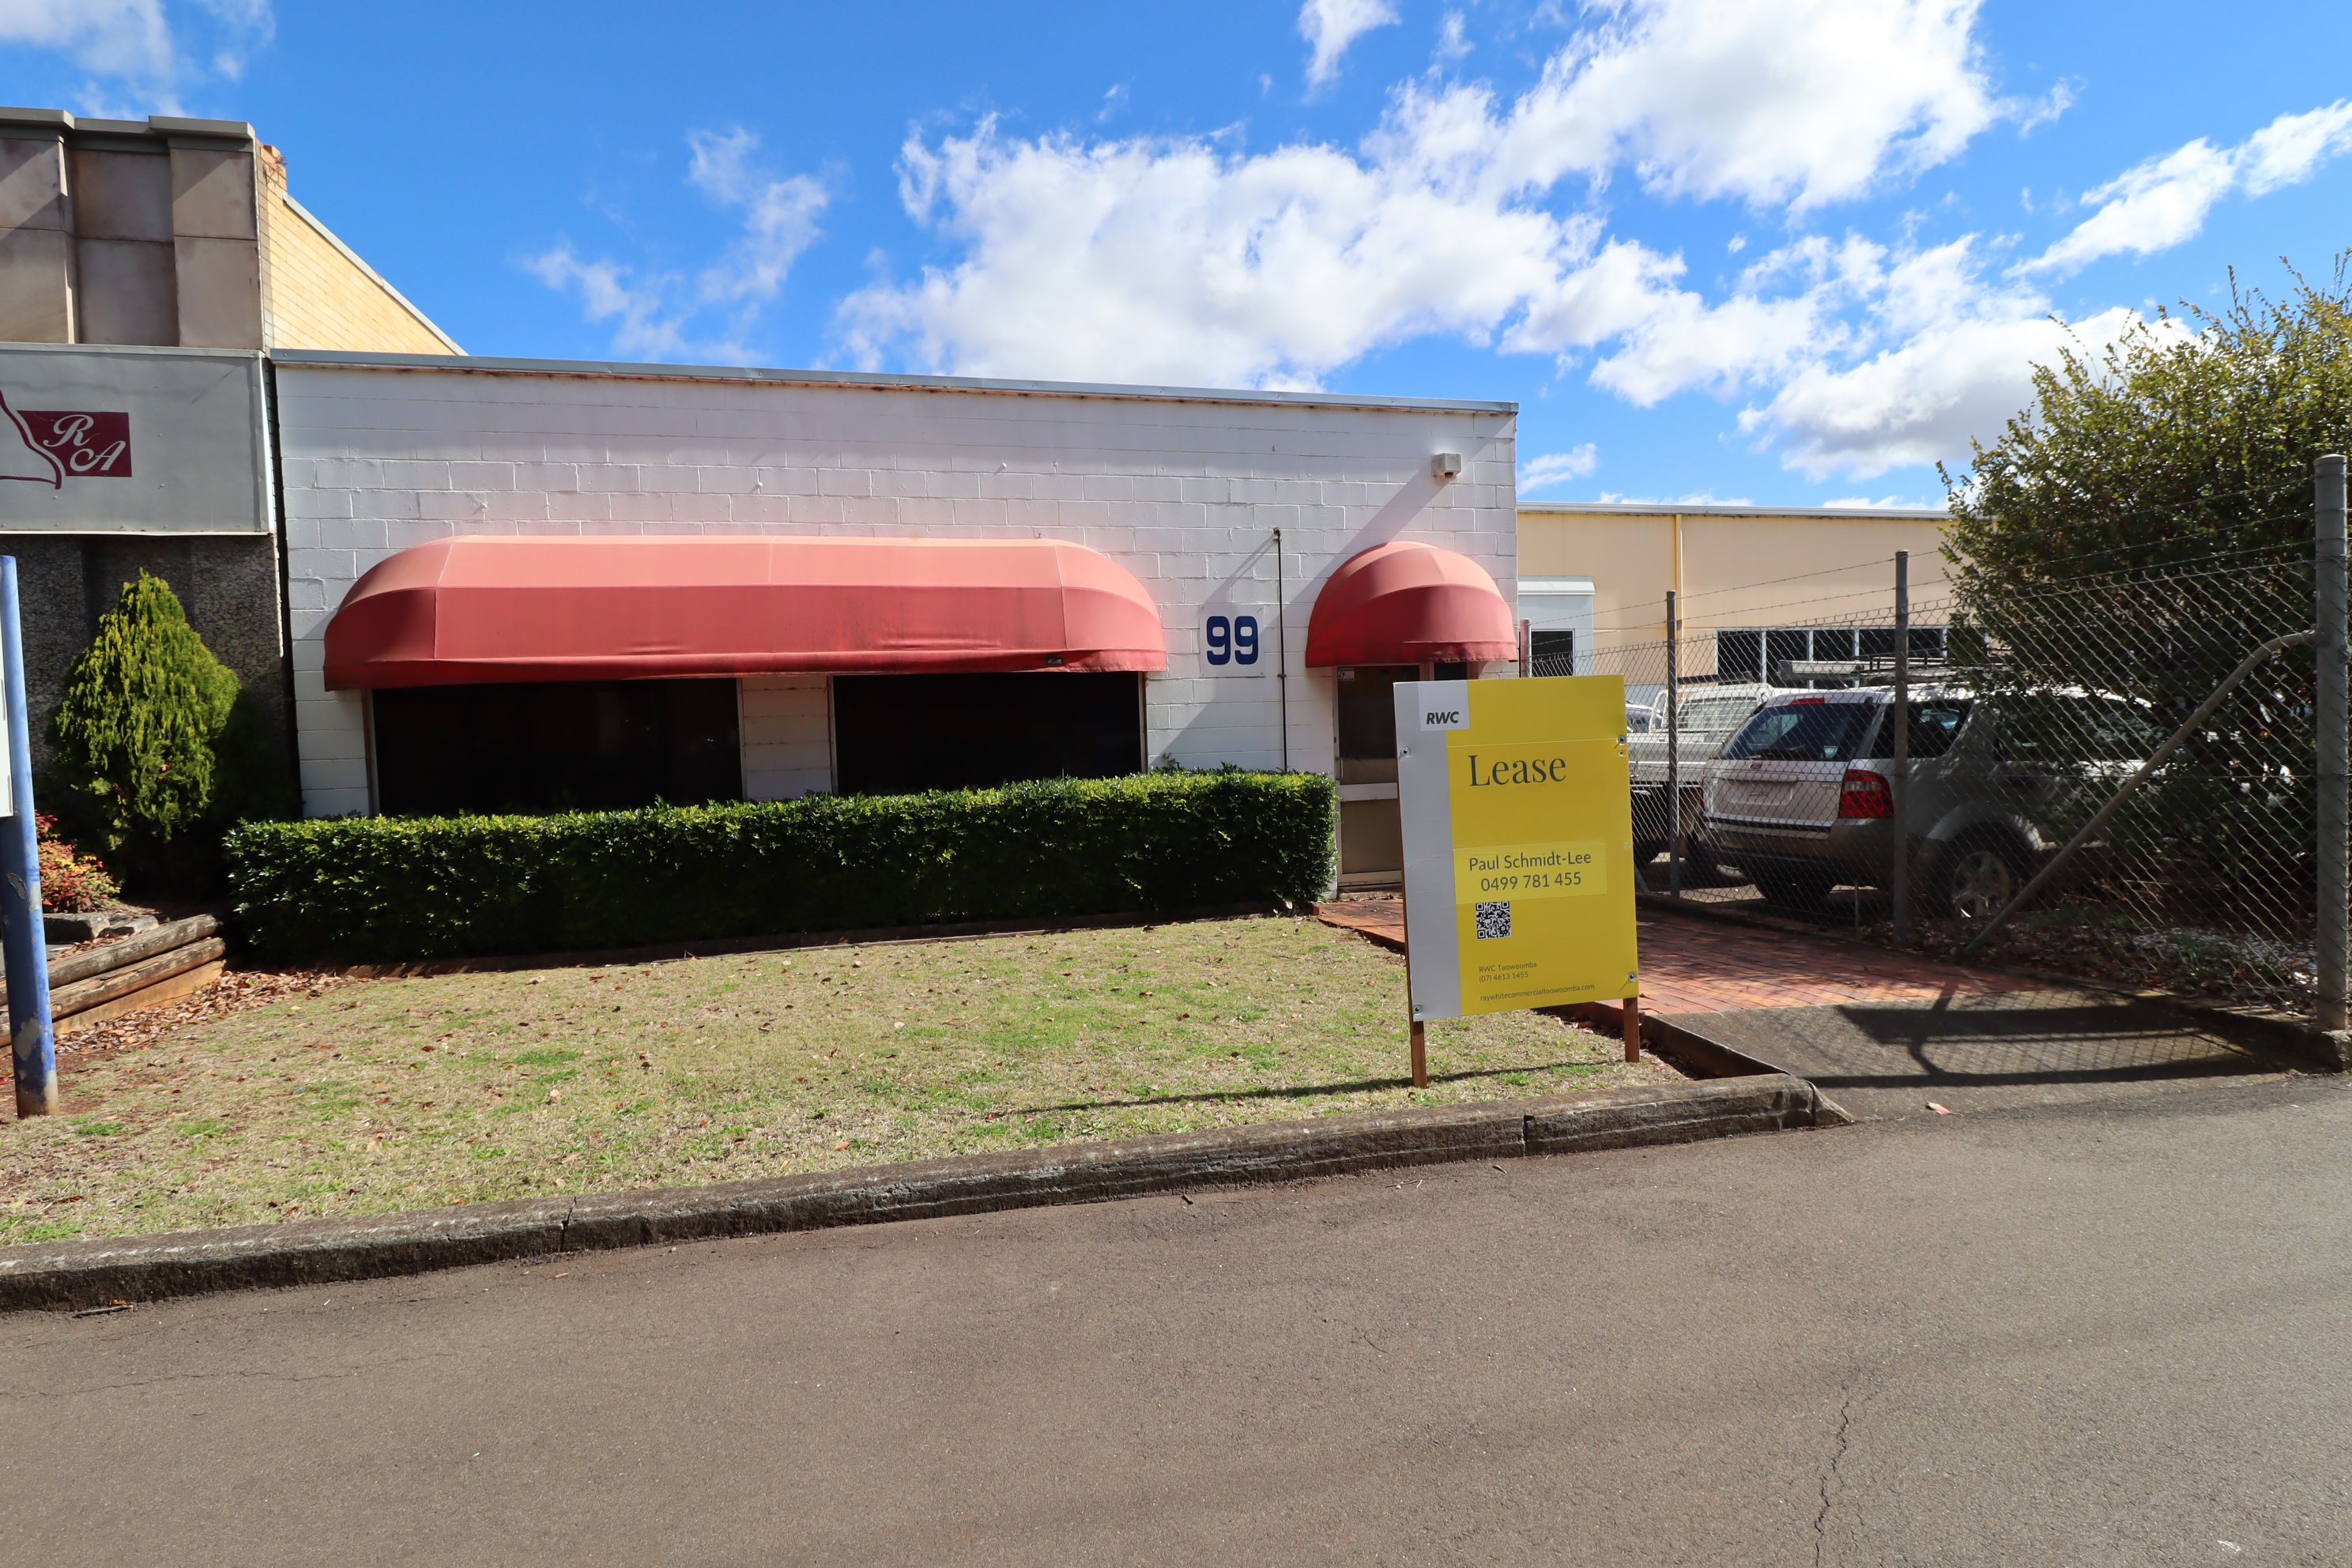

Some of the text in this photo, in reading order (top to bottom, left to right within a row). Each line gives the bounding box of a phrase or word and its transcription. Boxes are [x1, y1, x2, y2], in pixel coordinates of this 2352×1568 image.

[1206, 616, 1259, 665] 99
[1426, 710, 1460, 725] RWC
[1468, 754, 1567, 787] Lease
[1469, 851, 1592, 871] Paul Schmidt-Lee
[1480, 872, 1581, 891] 0499 781 455
[1497, 962, 1537, 971] Toowoomba
[1479, 974, 1492, 983] (07)
[1479, 983, 1595, 1002] raywhitecommercialtoowoomba.com
